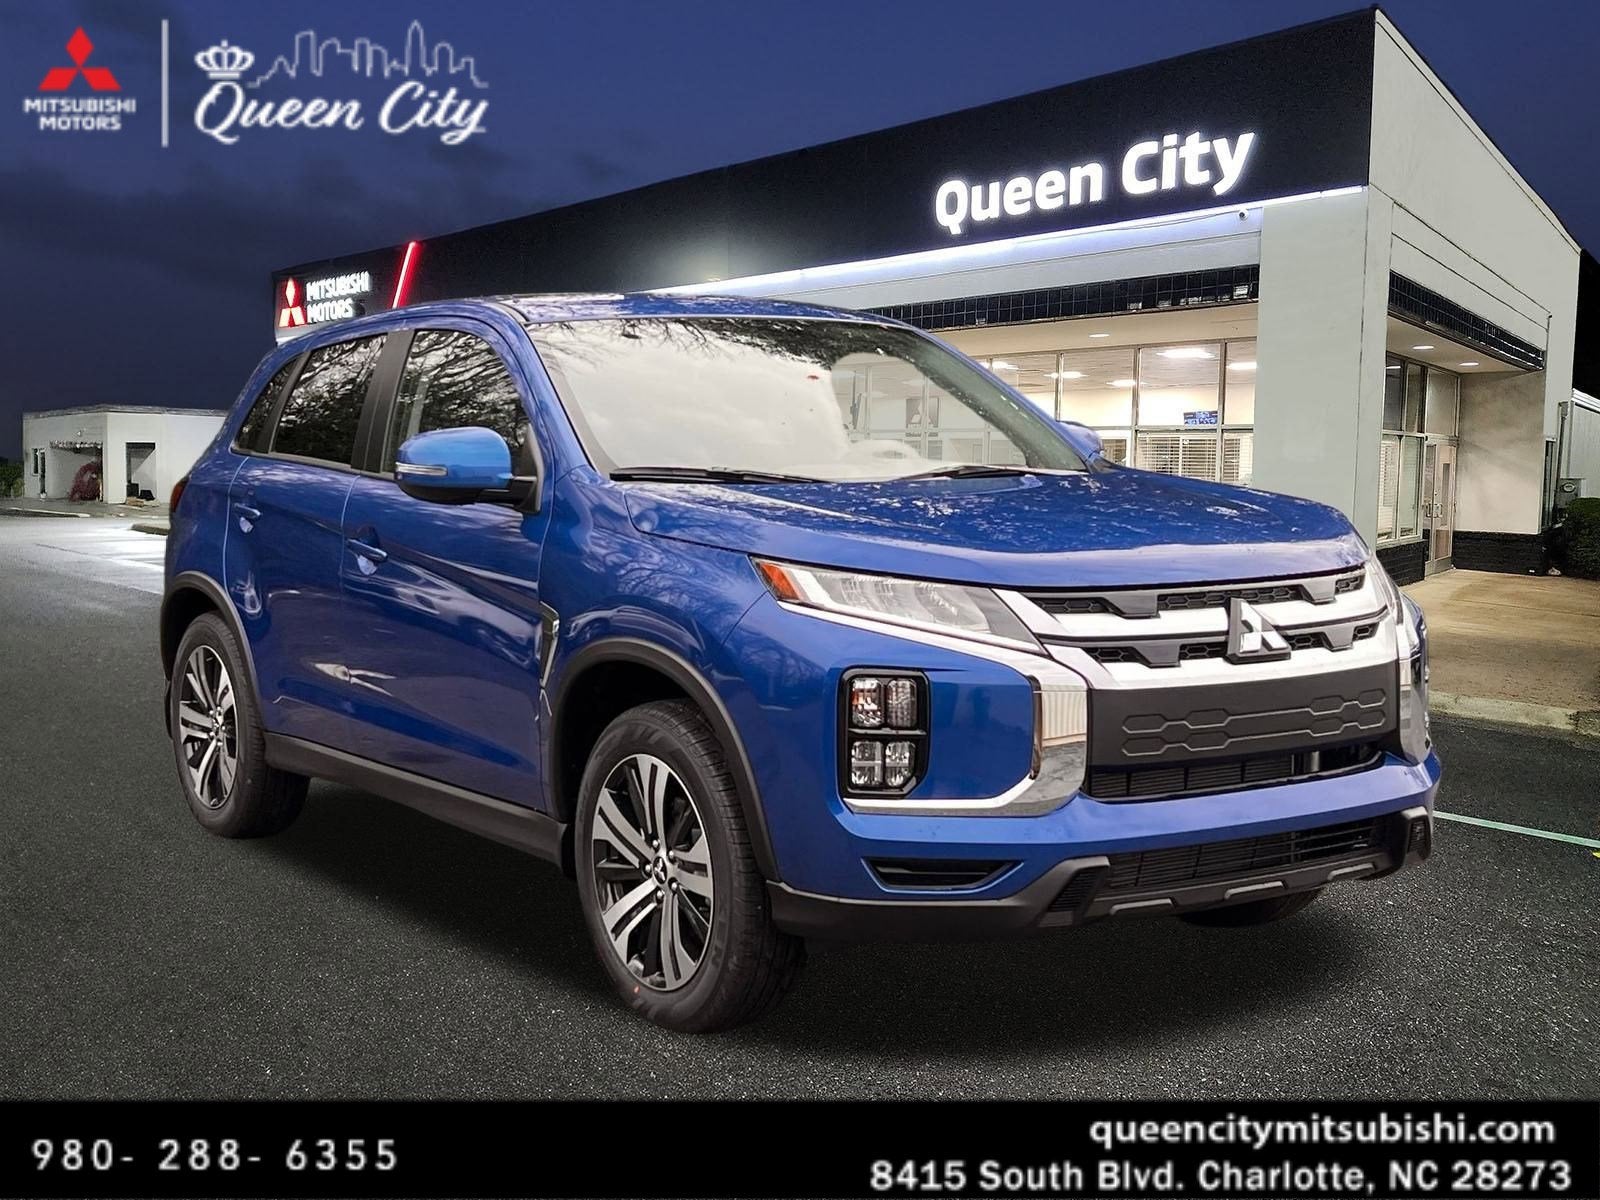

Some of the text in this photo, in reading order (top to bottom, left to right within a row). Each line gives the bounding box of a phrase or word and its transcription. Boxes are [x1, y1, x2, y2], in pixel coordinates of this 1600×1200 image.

[935, 132, 1255, 235] Queen City
[305, 271, 371, 301] MITSUBISHI
[306, 298, 354, 323] MOTORS
